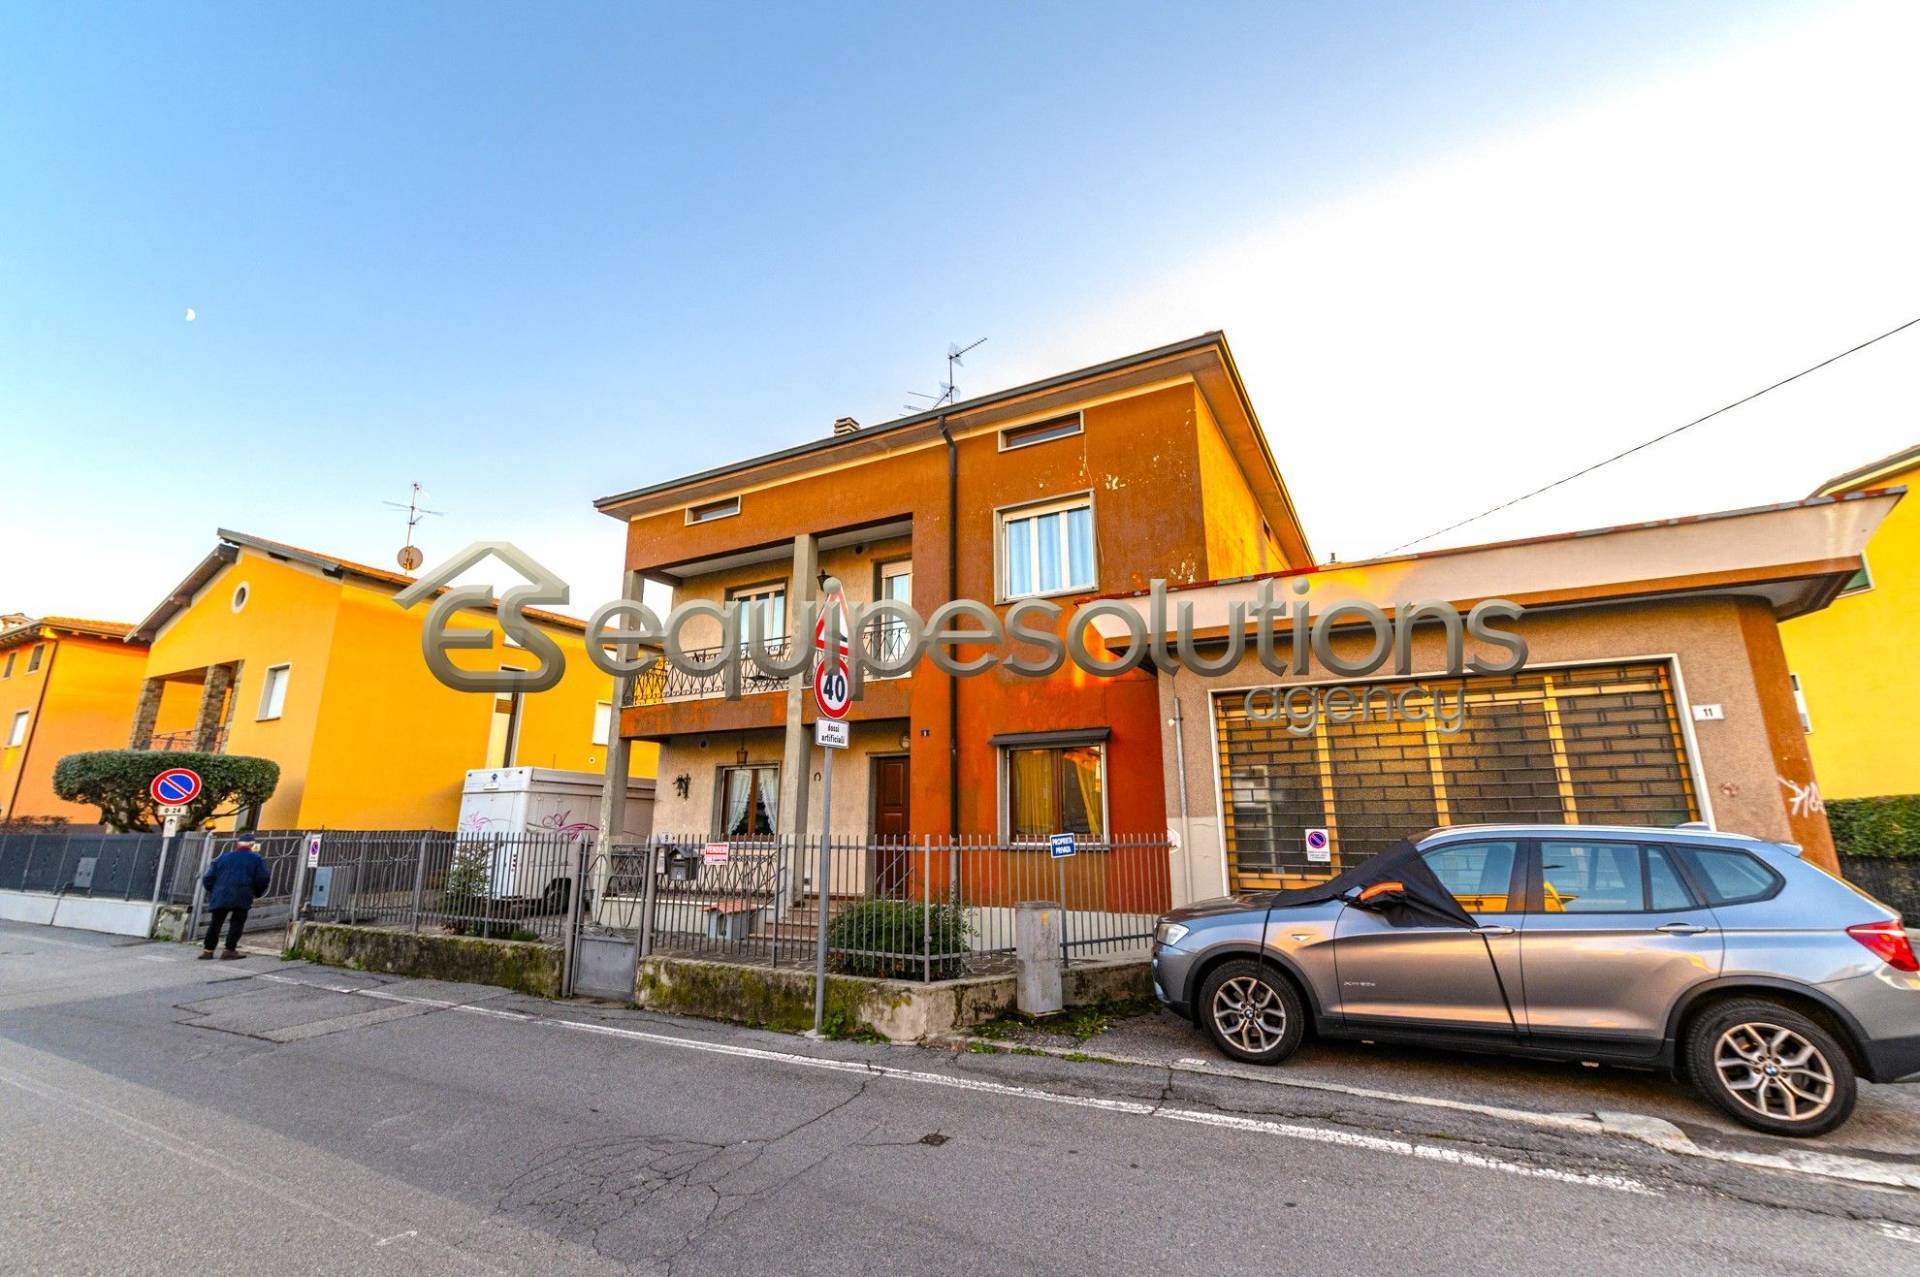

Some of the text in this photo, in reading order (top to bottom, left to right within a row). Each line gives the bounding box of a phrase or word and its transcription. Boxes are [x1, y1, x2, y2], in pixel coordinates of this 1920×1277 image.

[823, 670, 846, 702] 40
[1703, 708, 1713, 717] 11
[827, 723, 840, 733] dossi
[821, 734, 845, 744] artificiali
